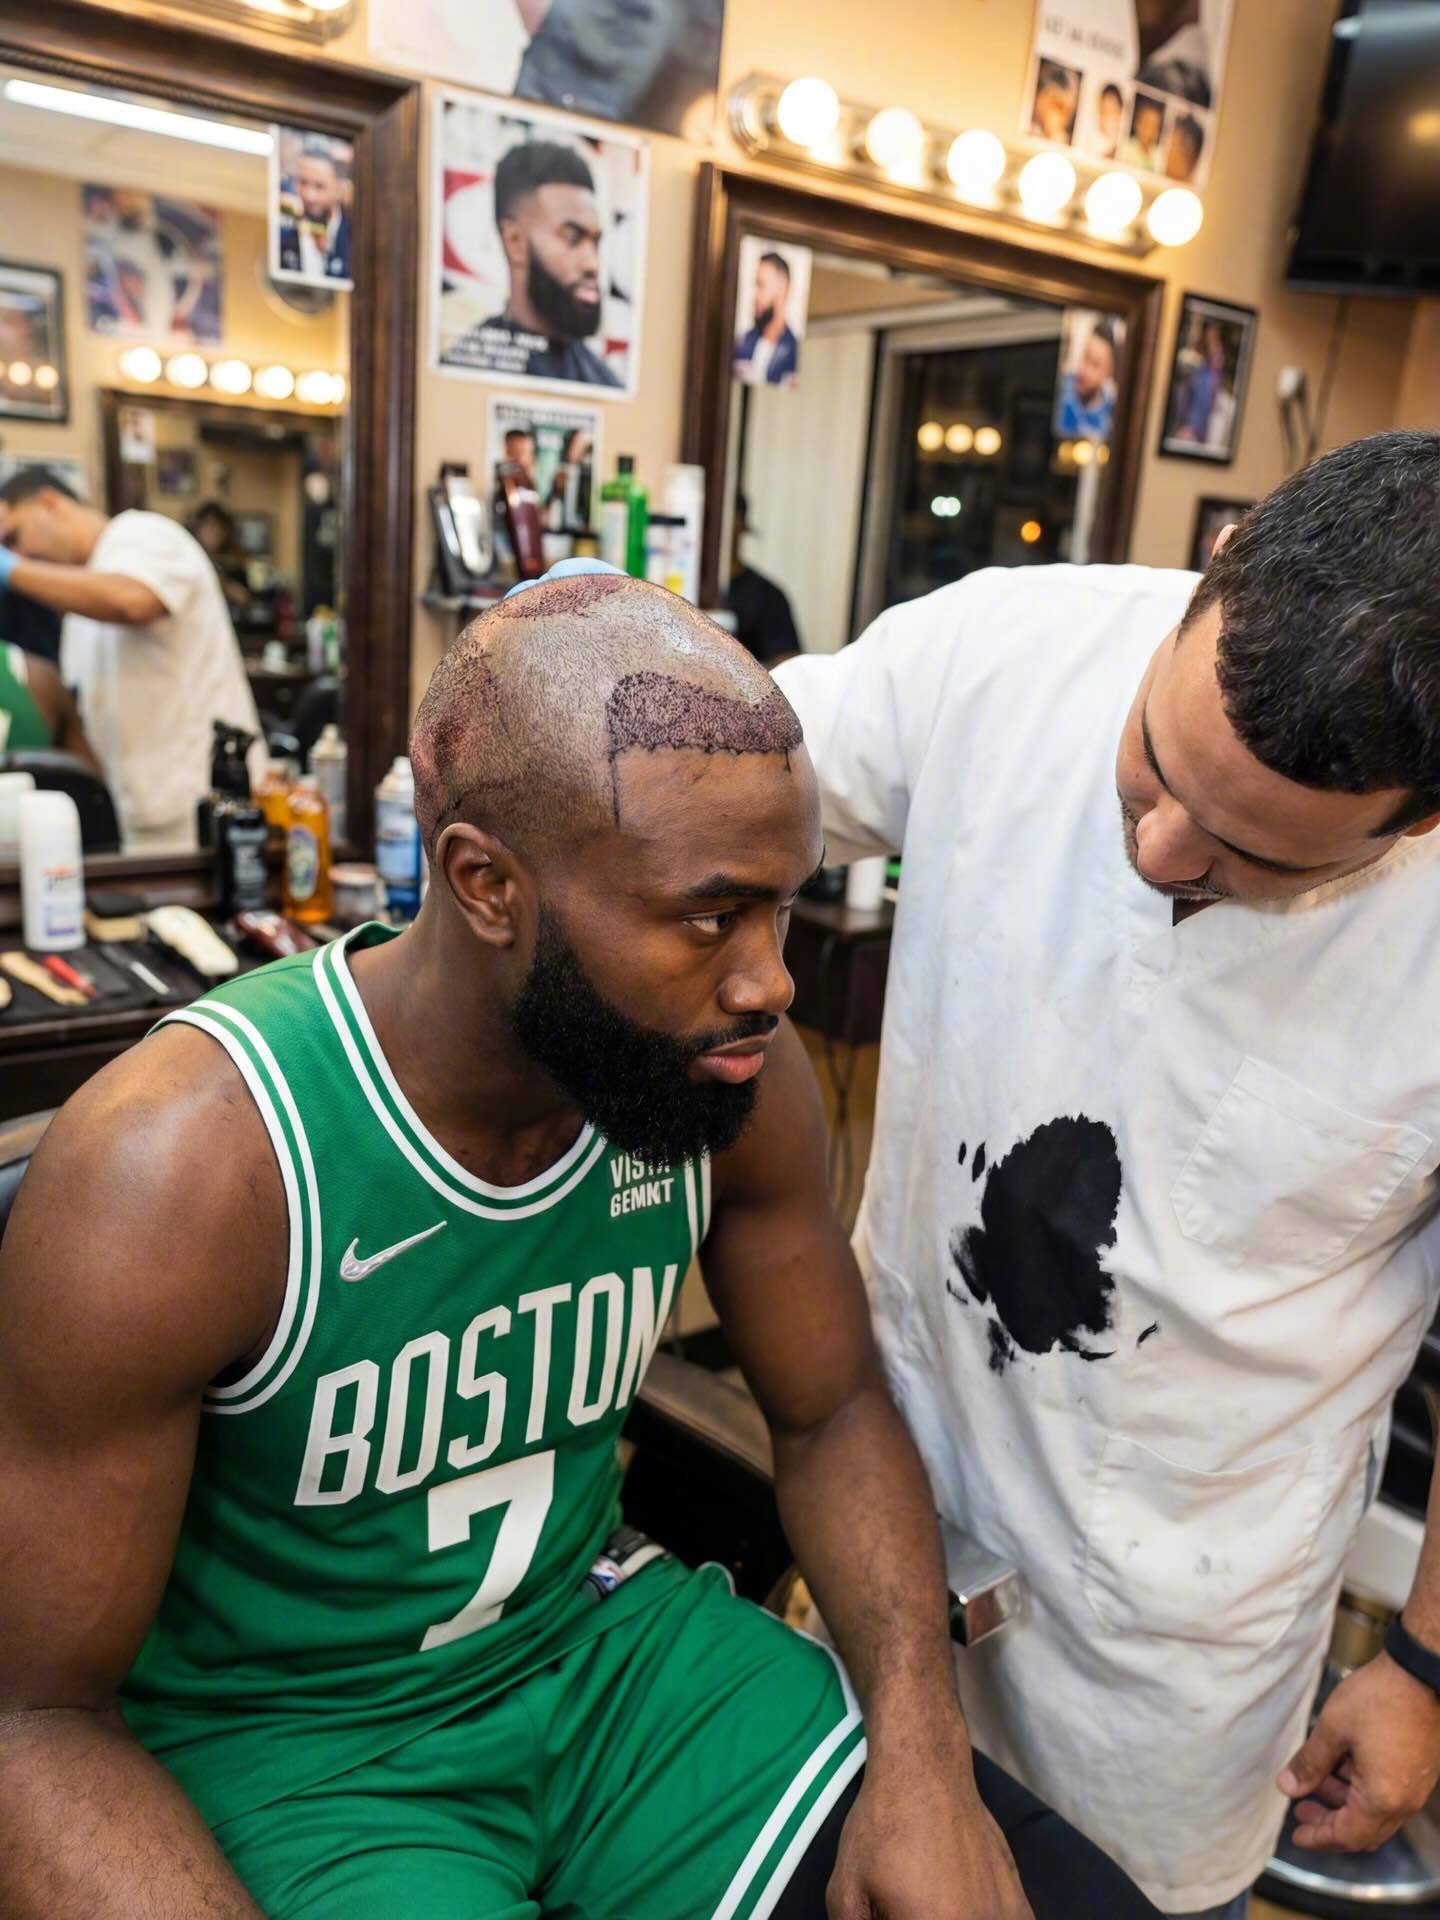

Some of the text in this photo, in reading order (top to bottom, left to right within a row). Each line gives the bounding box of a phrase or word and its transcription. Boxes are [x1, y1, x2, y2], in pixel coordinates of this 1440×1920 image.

[610, 1152, 671, 1188] VIS
[294, 1264, 678, 1506] BOSTON
[419, 1449, 556, 1652] 7
